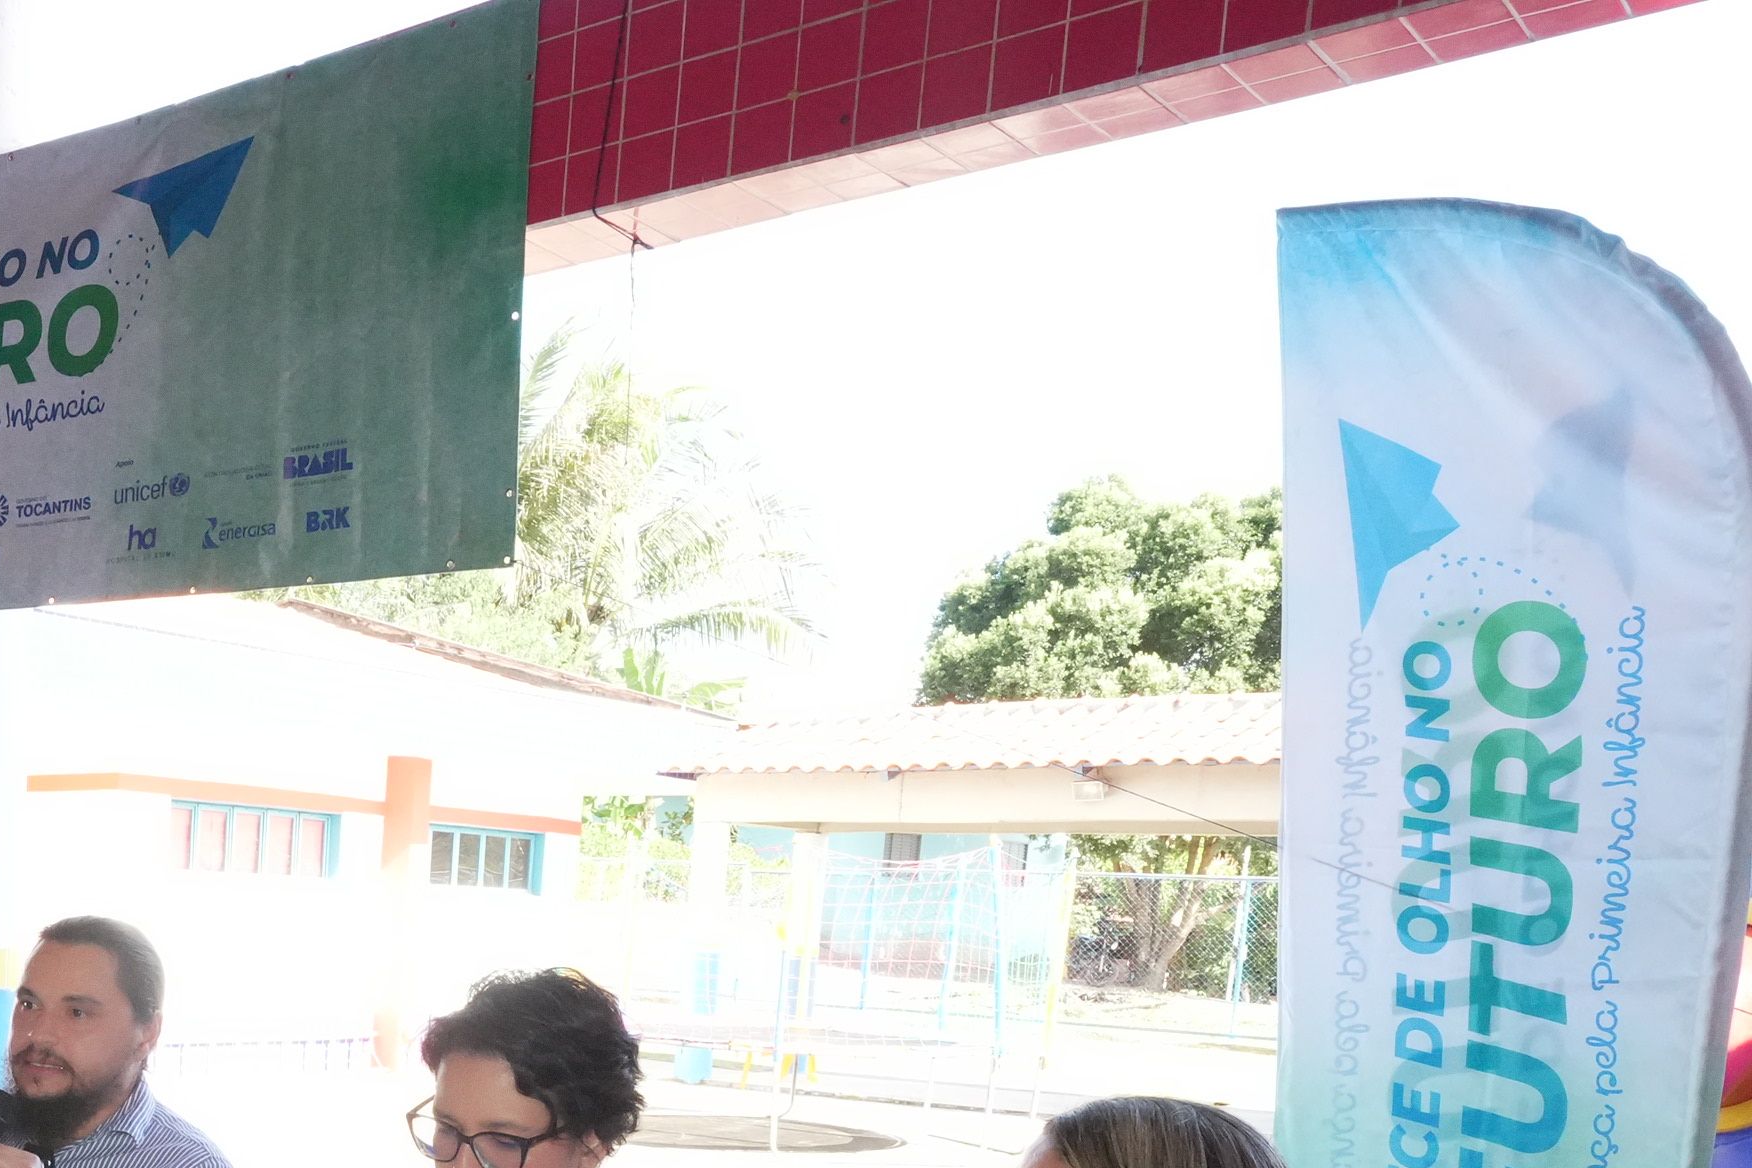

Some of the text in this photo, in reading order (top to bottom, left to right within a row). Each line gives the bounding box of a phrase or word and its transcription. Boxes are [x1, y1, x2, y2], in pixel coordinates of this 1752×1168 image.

[36, 229, 100, 279] NO
[5, 390, 105, 431] Infância
[283, 448, 354, 480] BRASIL
[16, 497, 92, 519] TOCANTINS
[114, 476, 167, 504] unicef
[306, 507, 350, 533] BRK
[1402, 640, 1452, 743] NO
[1601, 605, 1646, 788] Infância
[1397, 763, 1452, 955] OLHO
[1395, 973, 1446, 1070] DE
[1585, 1000, 1623, 1096] pela
